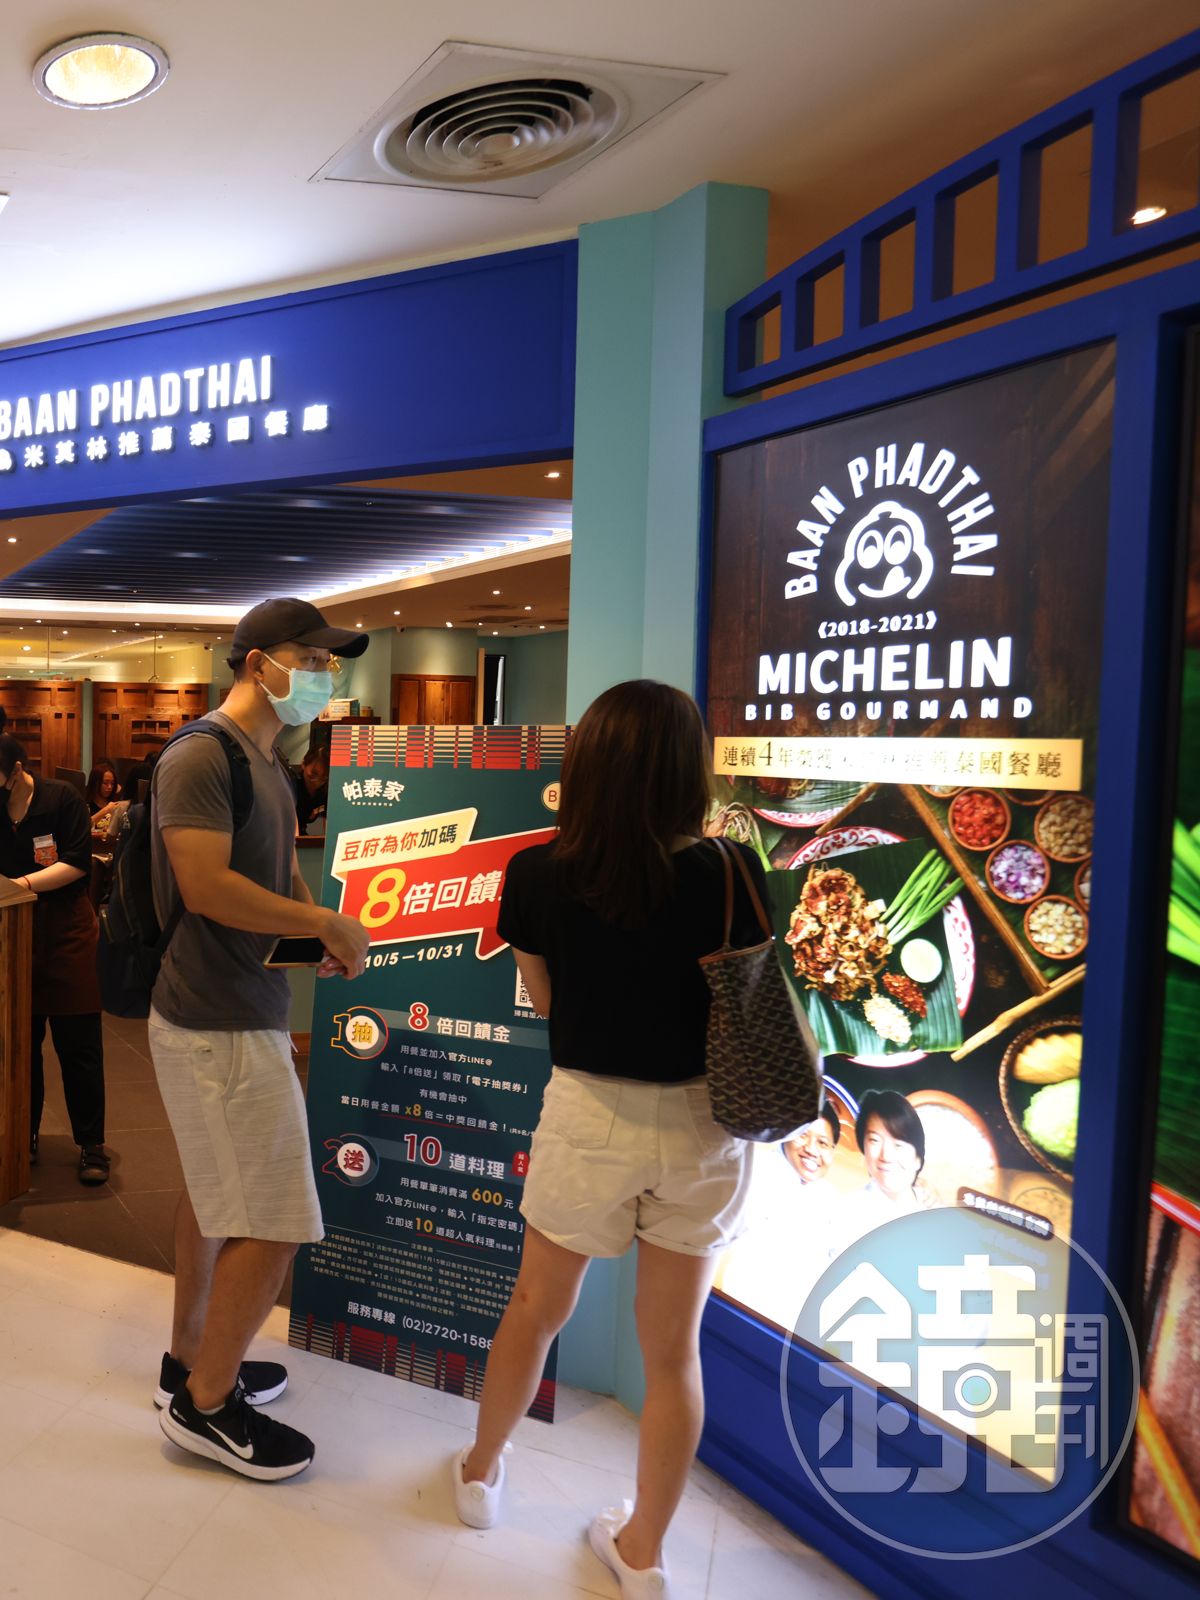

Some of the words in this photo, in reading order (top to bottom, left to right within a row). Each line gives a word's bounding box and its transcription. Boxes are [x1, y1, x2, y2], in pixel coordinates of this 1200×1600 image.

[90, 355, 271, 427] PHADTHAI
[784, 486, 846, 600] BAAN
[847, 442, 999, 577] PHADTHAI
[758, 636, 1012, 696] MICHELIN
[744, 702, 794, 722] BIB
[816, 697, 1034, 721] GOURMAND
[342, 778, 405, 802] 帕泰家
[341, 823, 458, 862] 豆府為你加碼
[359, 867, 503, 929] 8倍回饋
[436, 1017, 511, 1044] 倍回饋金
[343, 1149, 365, 1172] 送
[448, 1153, 505, 1180] 道料理
[347, 1301, 396, 1326] 服務專線
